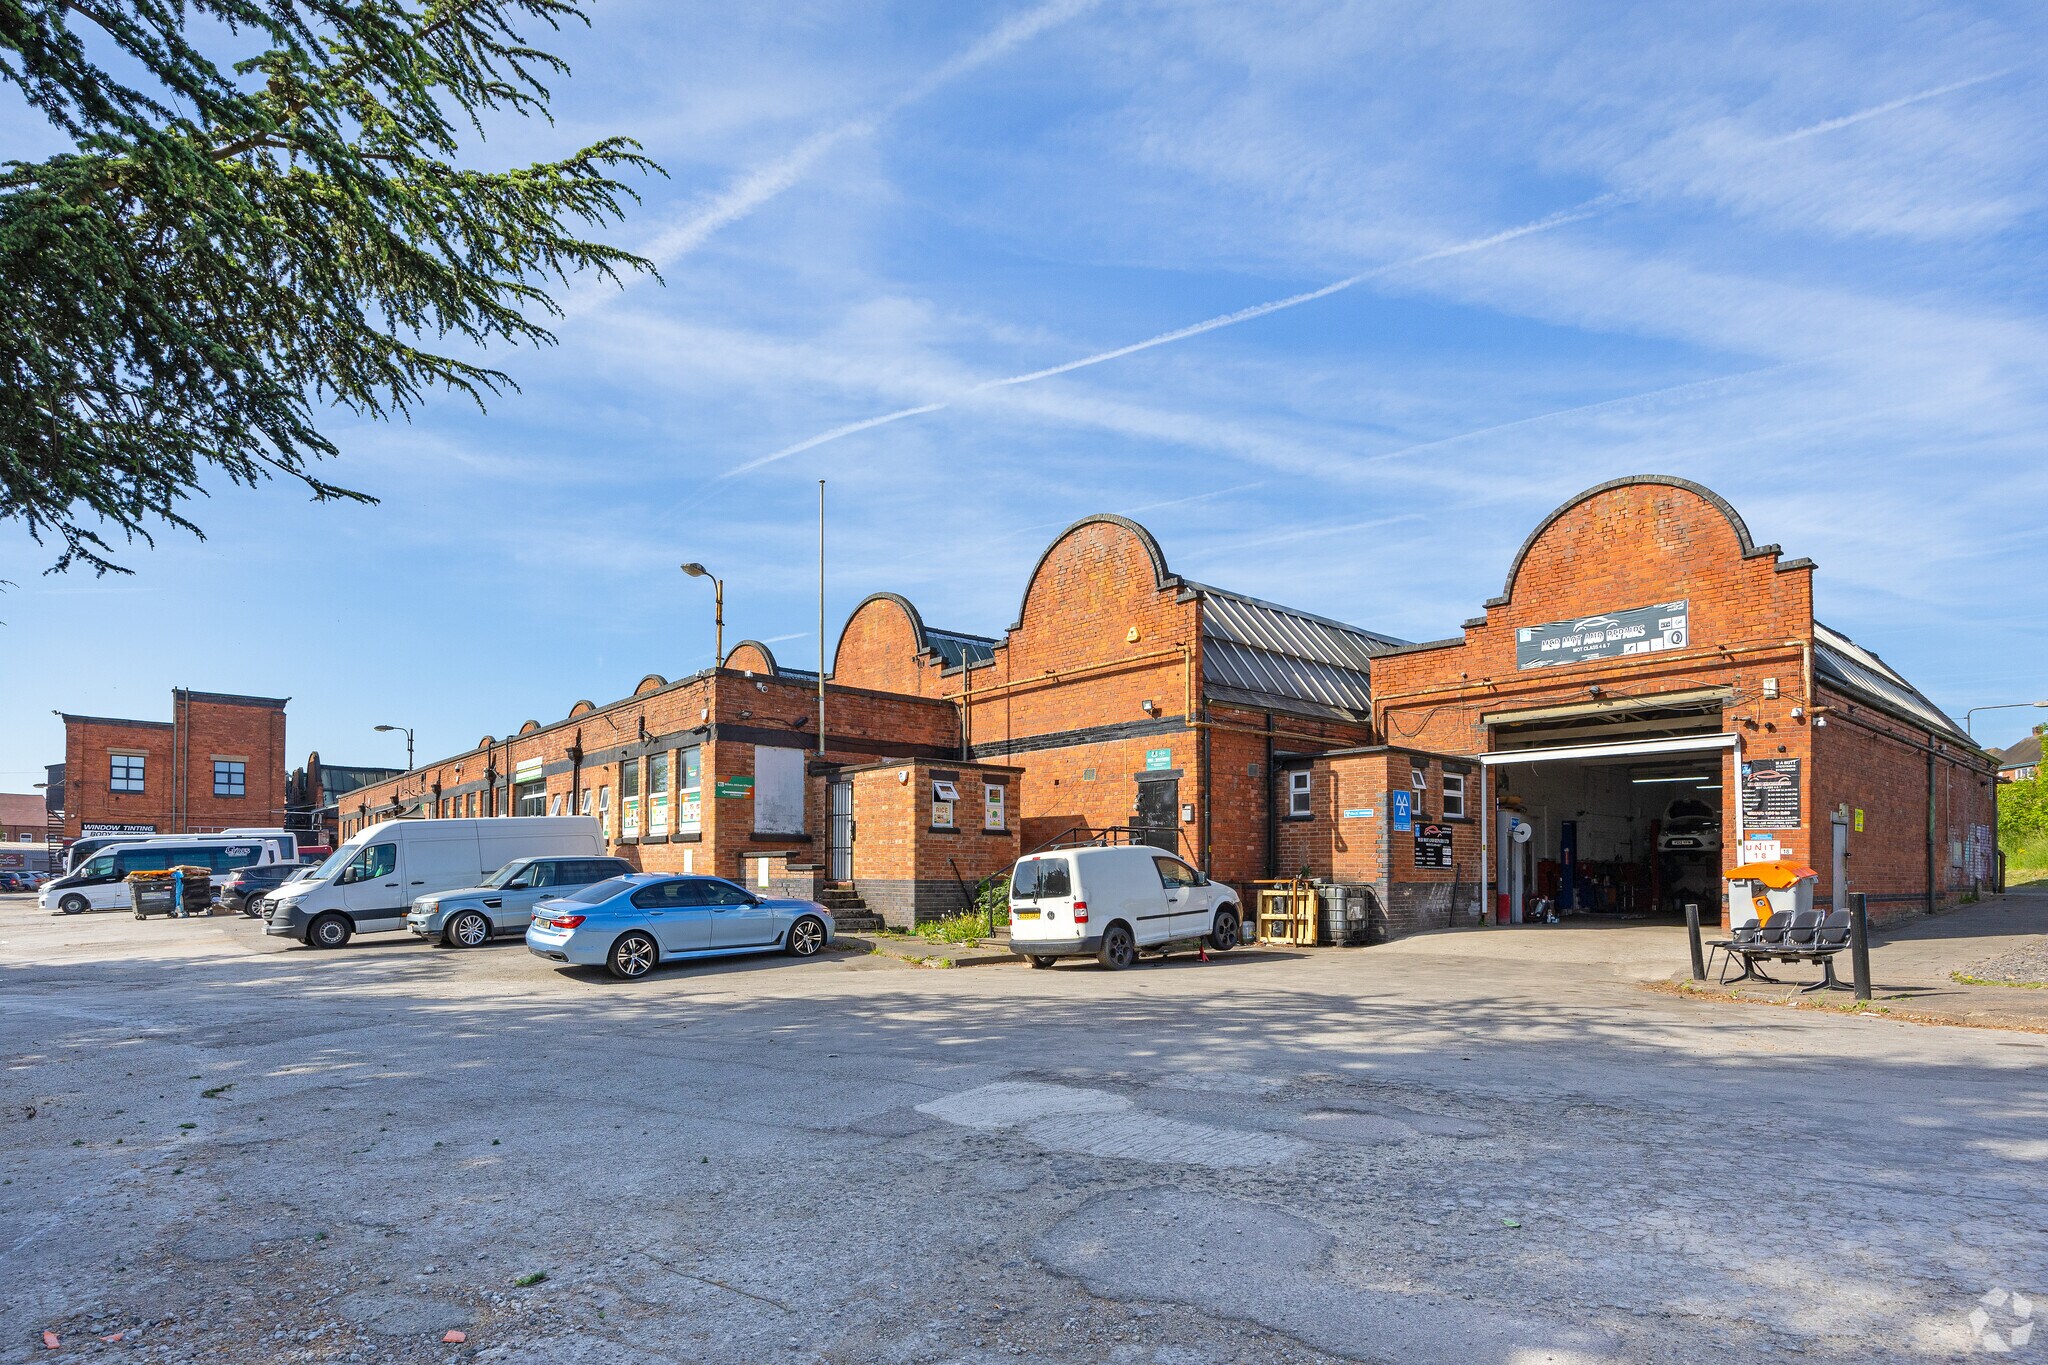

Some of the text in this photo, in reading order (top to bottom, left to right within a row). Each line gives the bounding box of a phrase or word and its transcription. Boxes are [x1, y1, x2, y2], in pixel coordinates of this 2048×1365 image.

[1562, 634, 1582, 648] MOT
[1583, 631, 1604, 645] AND
[1606, 624, 1645, 641] REPAIRS
